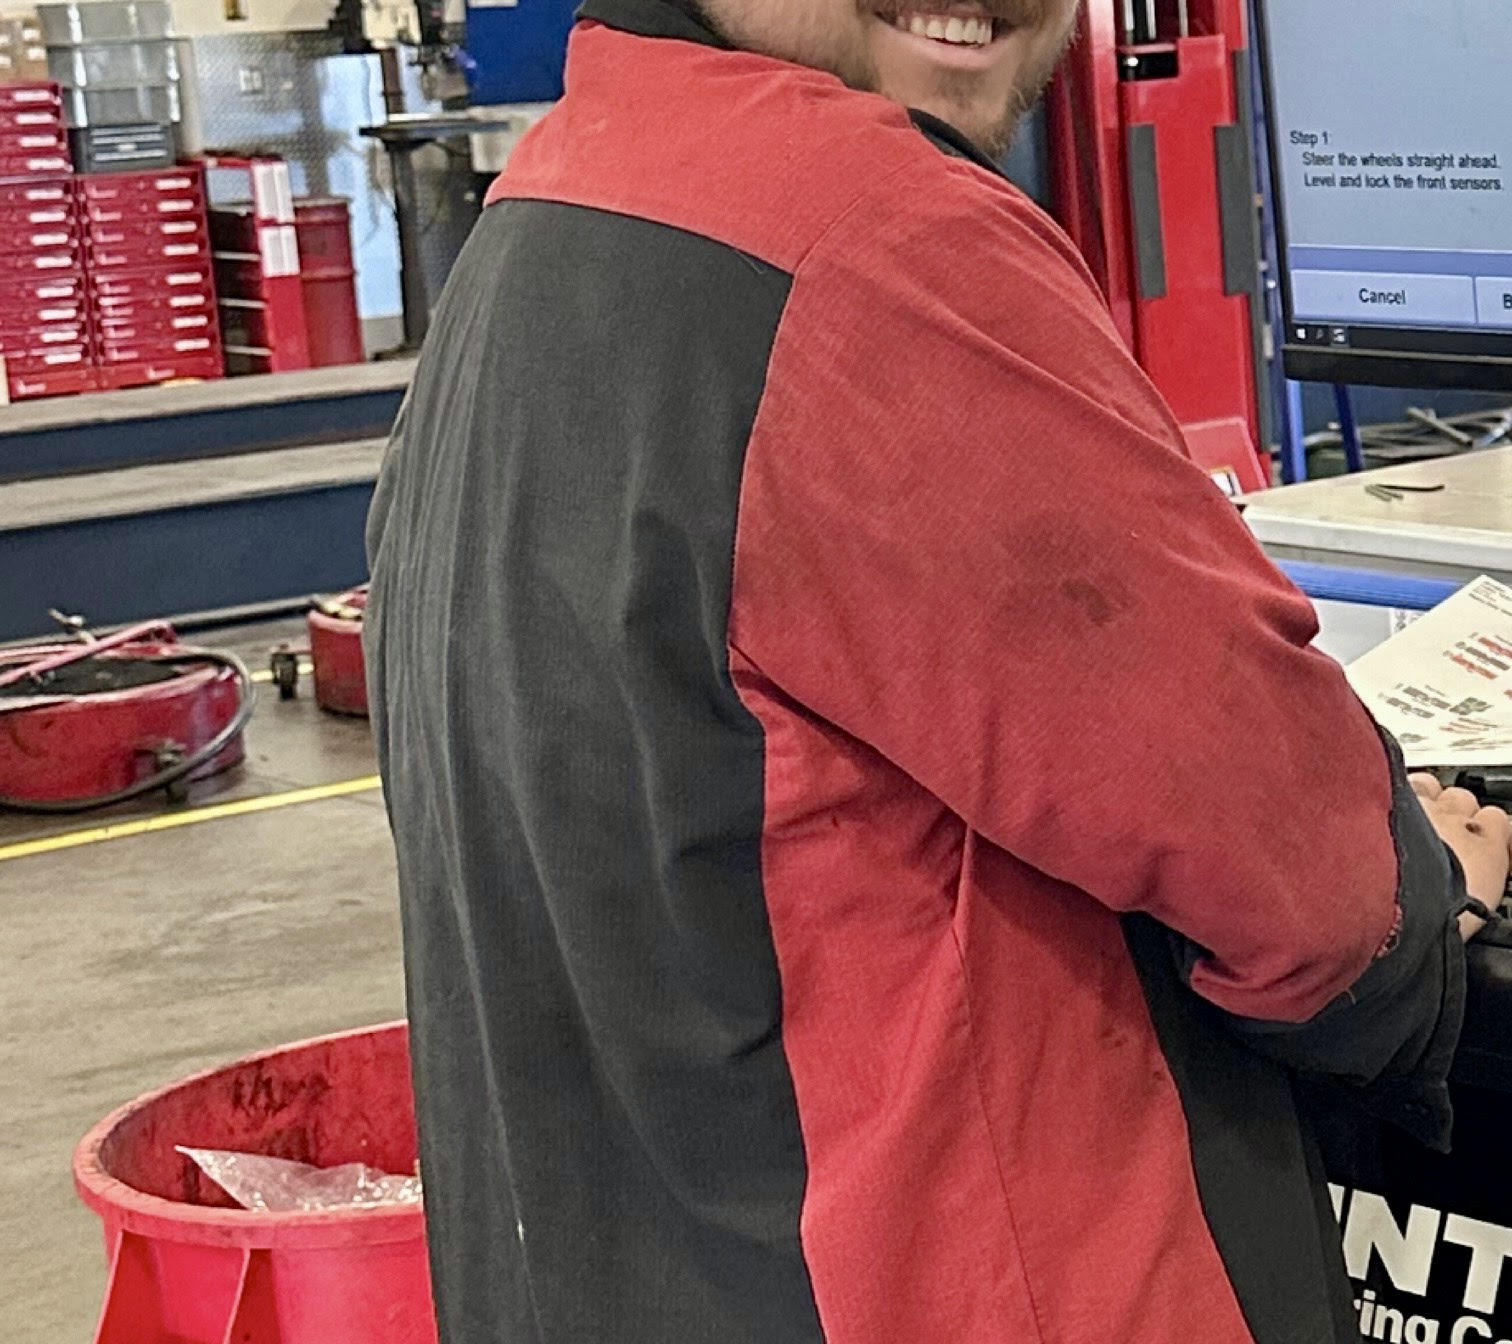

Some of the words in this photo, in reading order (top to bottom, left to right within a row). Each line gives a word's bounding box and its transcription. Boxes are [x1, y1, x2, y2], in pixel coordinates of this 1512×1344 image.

[1289, 129, 1318, 148] Step
[1302, 152, 1334, 167] Steer
[1338, 152, 1357, 167] the
[1361, 152, 1404, 168] wheels
[1407, 154, 1454, 171] straight
[1304, 173, 1336, 187] Level
[1339, 174, 1361, 188] and
[1365, 174, 1389, 188] lock
[1394, 174, 1414, 189] the
[1417, 175, 1446, 190] front
[1358, 288, 1406, 305] Cancel
